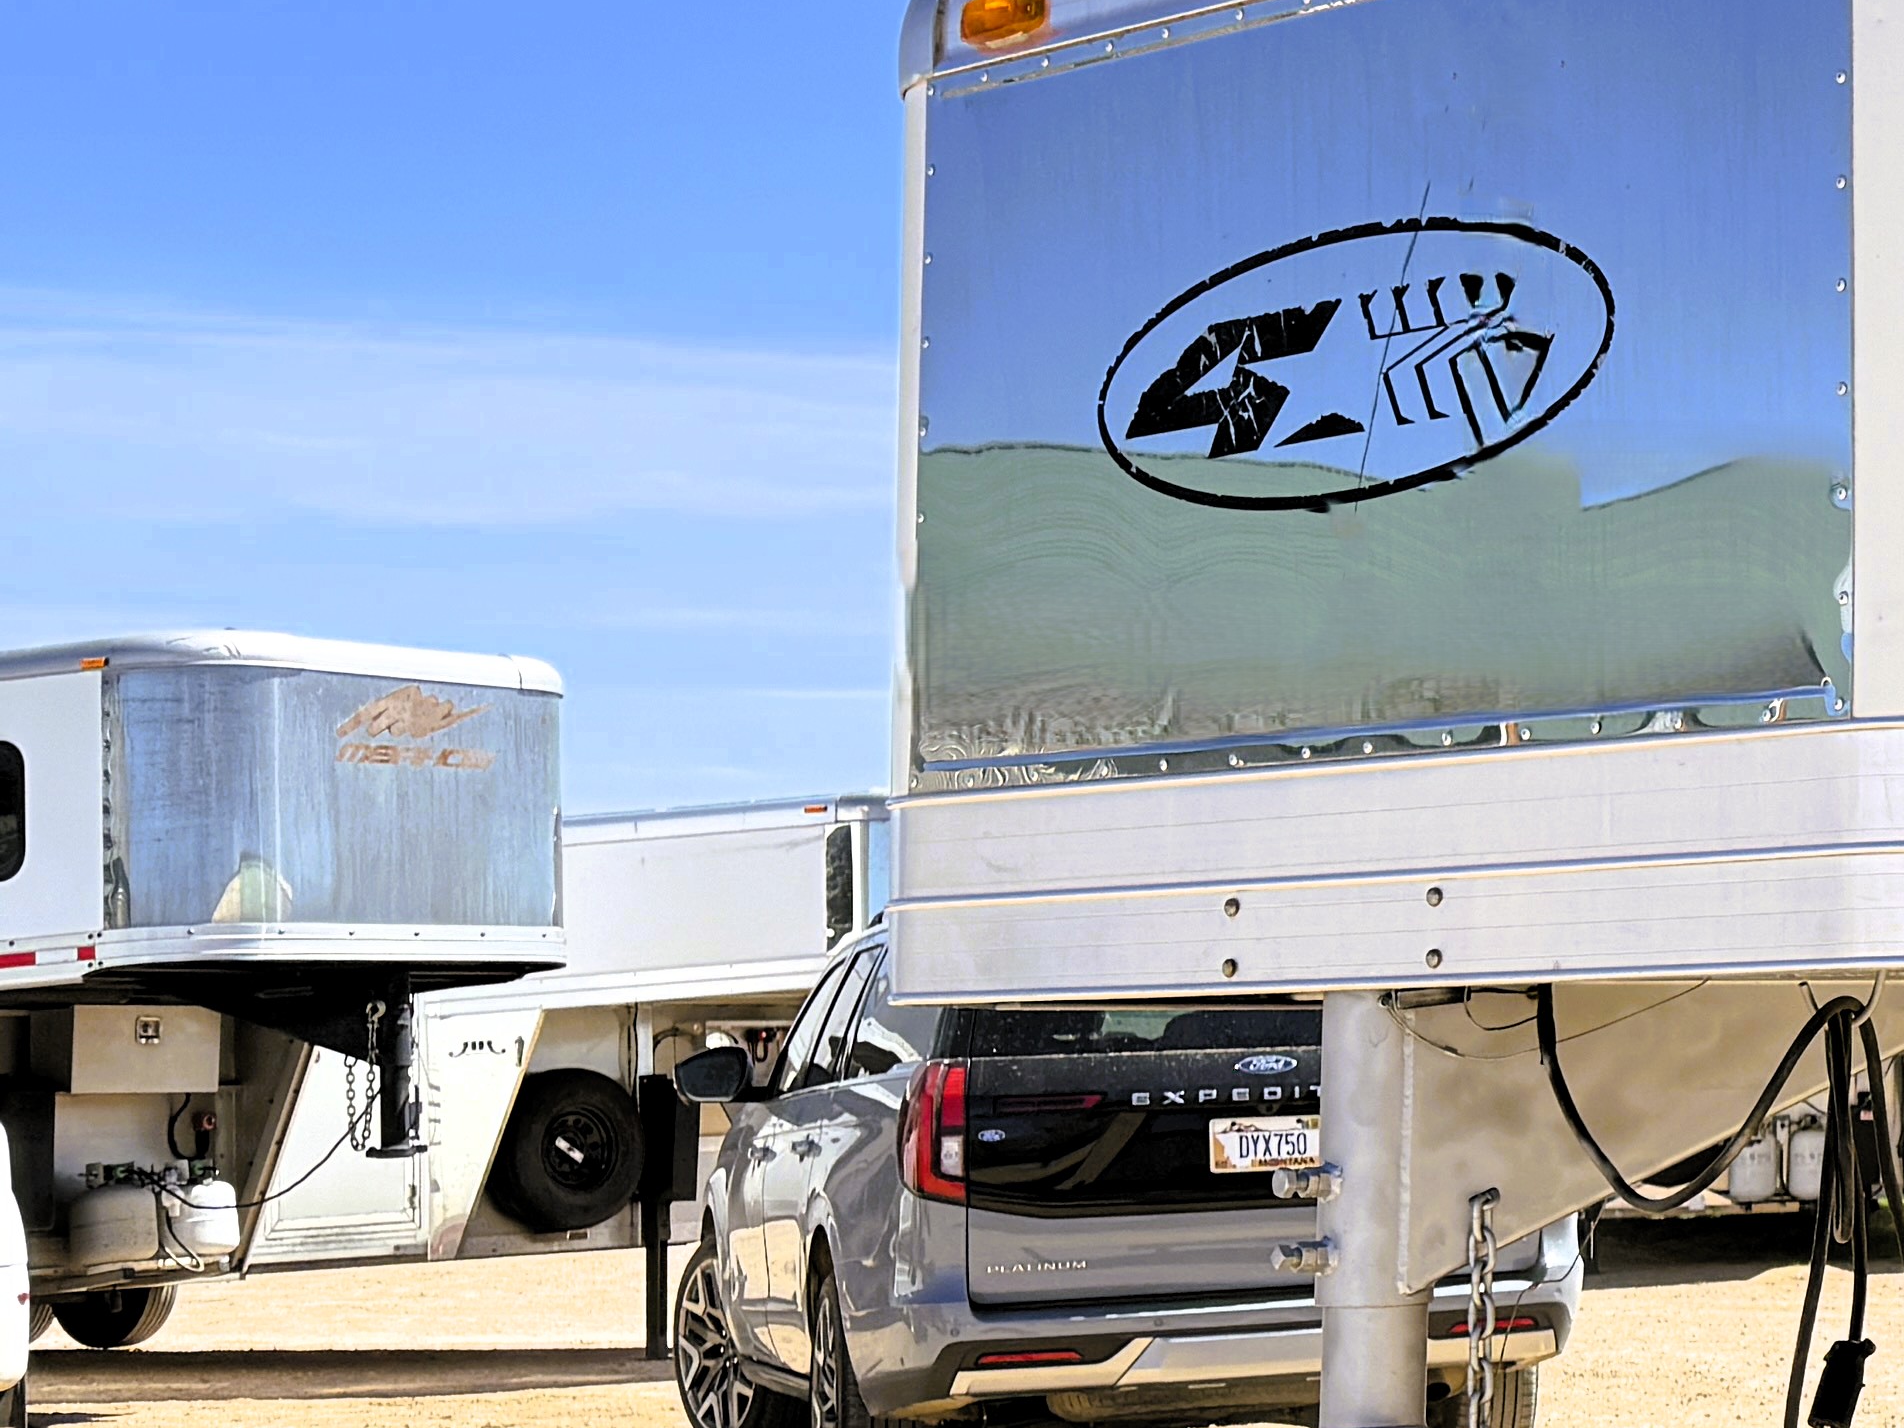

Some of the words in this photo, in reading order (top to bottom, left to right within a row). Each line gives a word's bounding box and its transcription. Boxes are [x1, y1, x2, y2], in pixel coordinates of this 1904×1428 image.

[1249, 1055, 1285, 1072] Ford
[1238, 1132, 1307, 1159] DYX750
[986, 1259, 1088, 1274] PLATINUM
